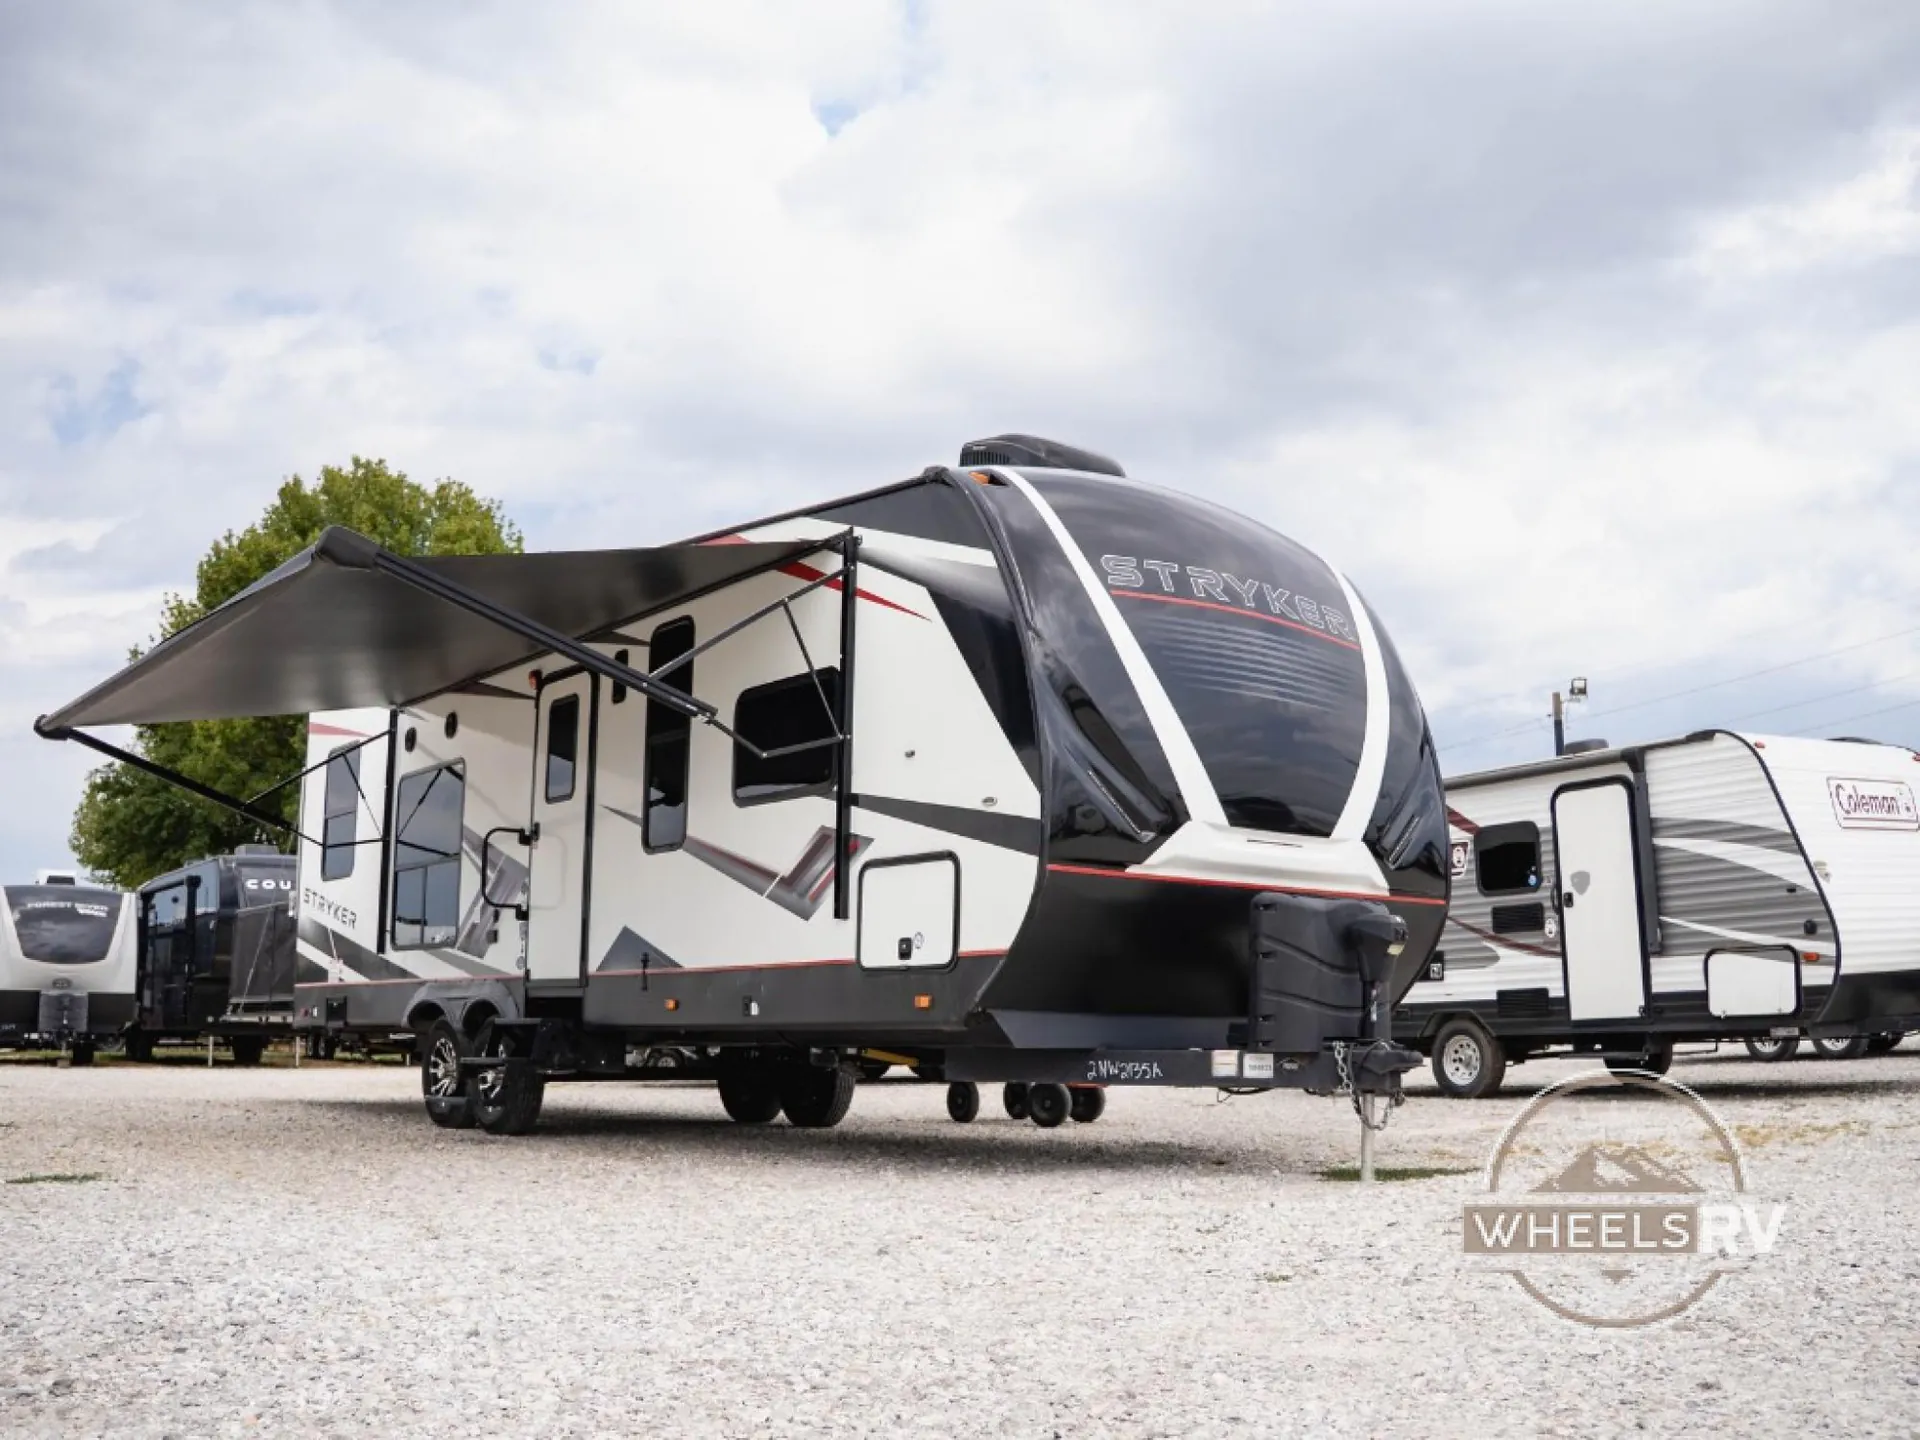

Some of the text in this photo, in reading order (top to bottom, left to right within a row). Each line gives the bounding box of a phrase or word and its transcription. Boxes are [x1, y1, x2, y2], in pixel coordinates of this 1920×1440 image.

[1100, 554, 1359, 641] STRYKER
[1835, 783, 1901, 815] Coleman
[303, 887, 357, 930] STRYKER
